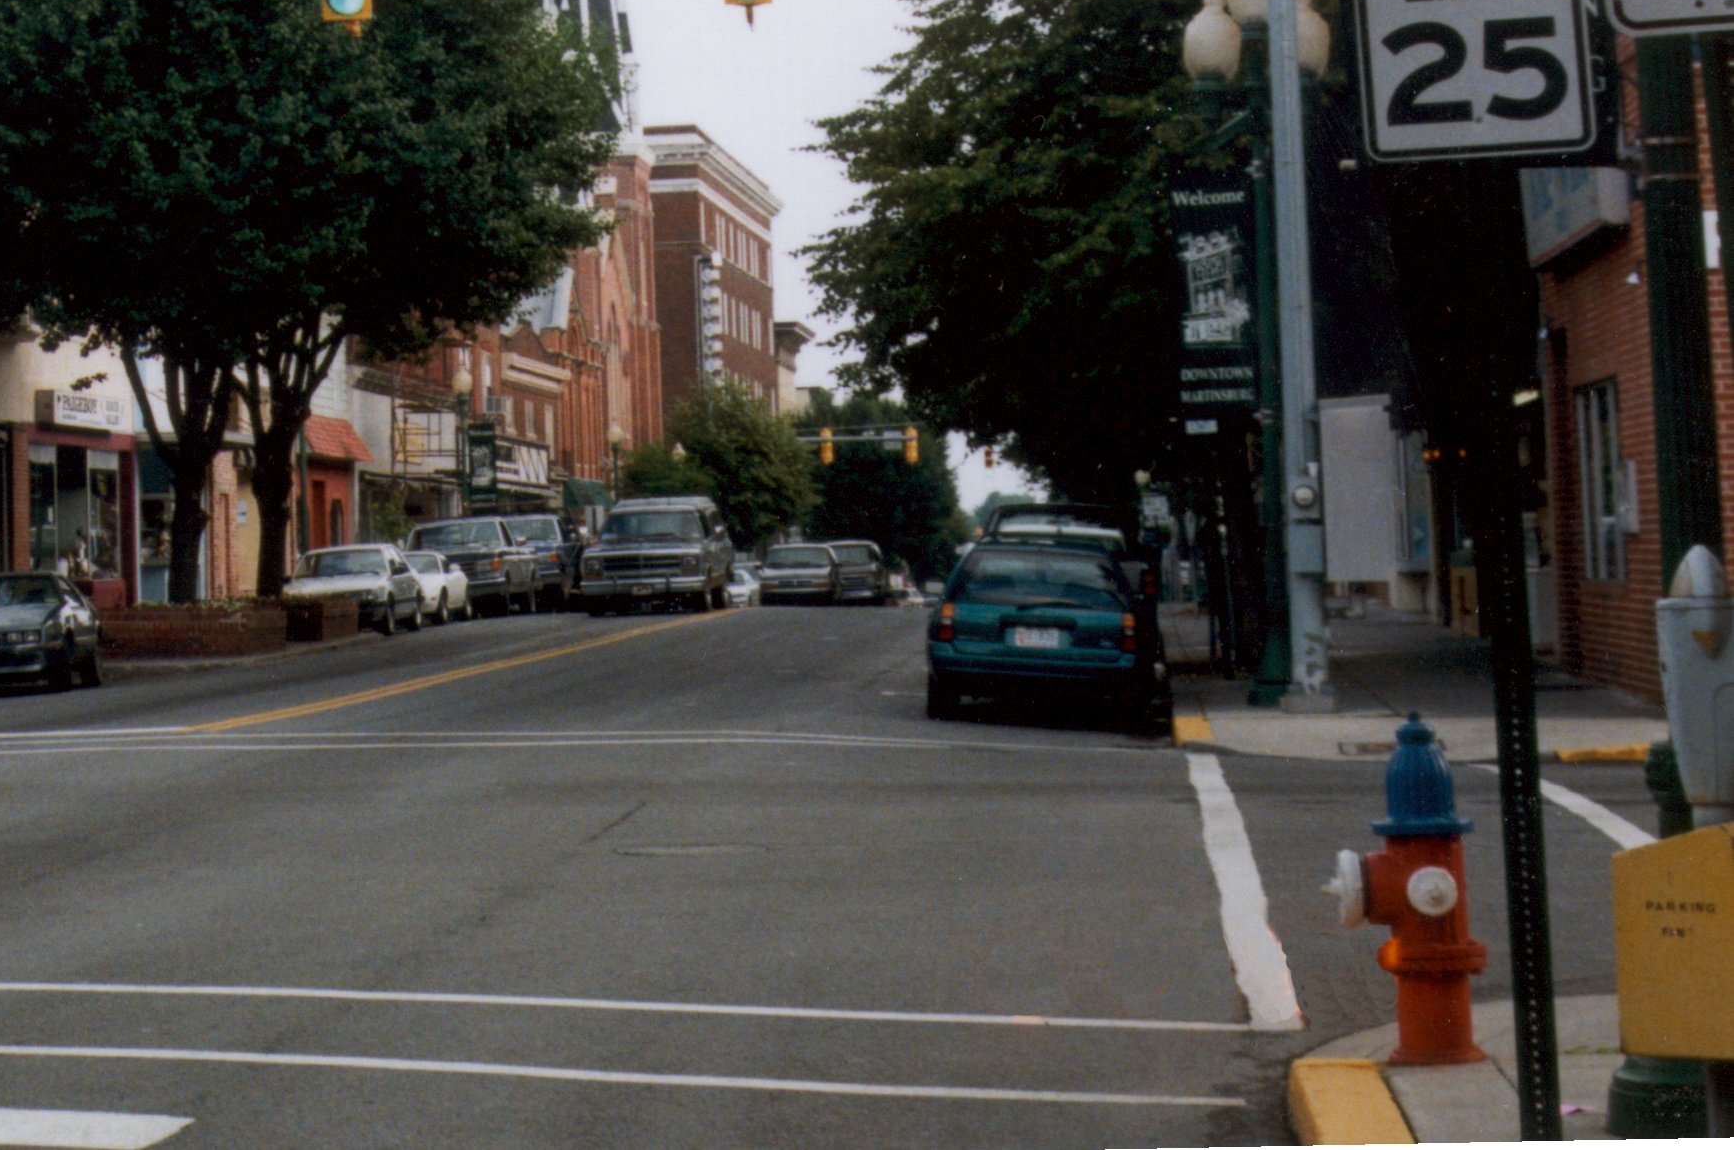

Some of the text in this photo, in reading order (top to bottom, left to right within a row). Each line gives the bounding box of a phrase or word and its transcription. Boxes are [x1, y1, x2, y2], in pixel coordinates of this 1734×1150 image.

[1380, 15, 1570, 128] 25
[1171, 189, 1245, 206] Welcome
[1180, 366, 1254, 381] DOWNTOWN
[1645, 900, 1716, 914] PARKING
